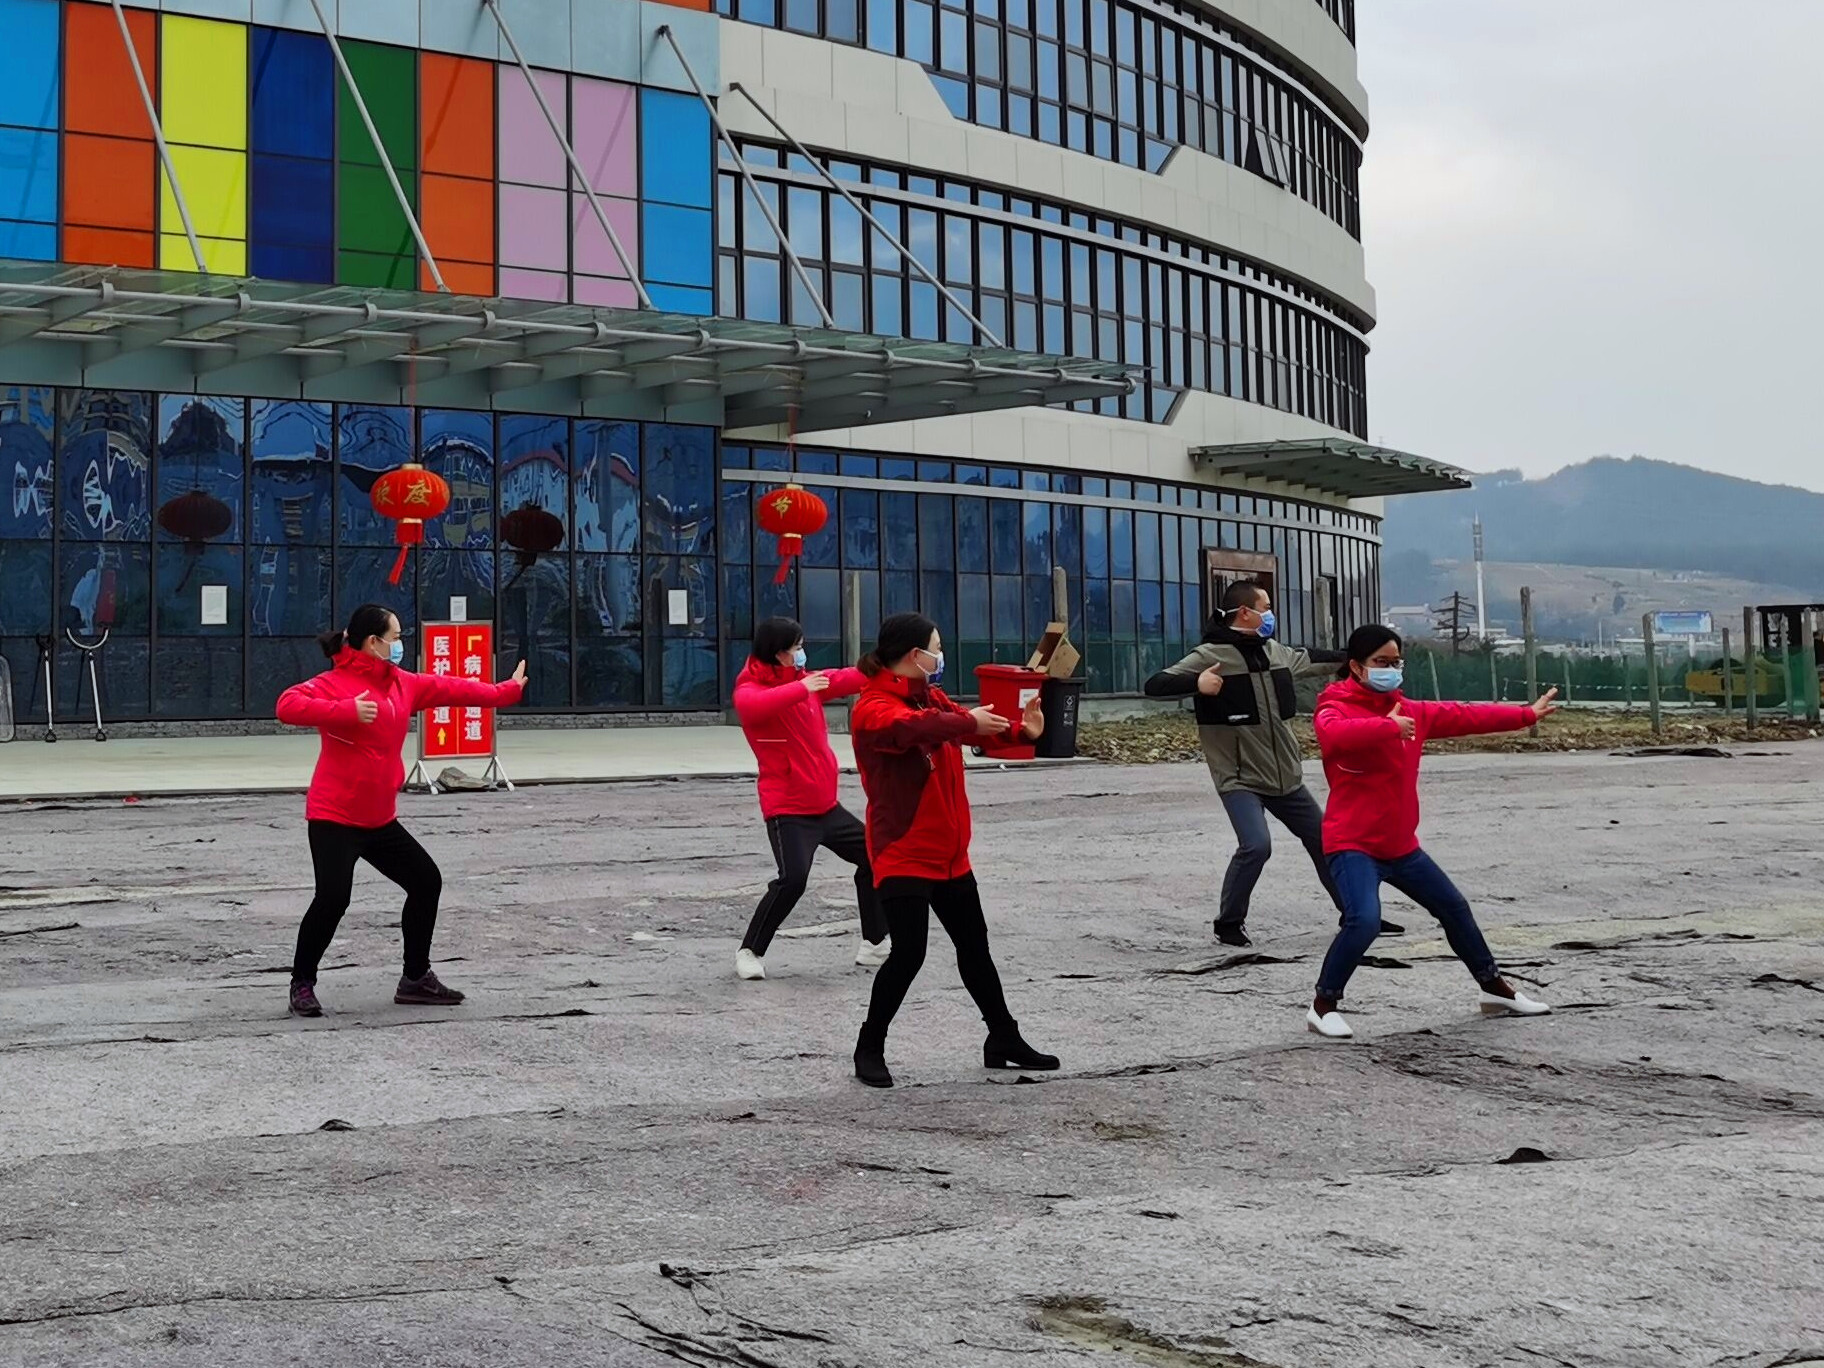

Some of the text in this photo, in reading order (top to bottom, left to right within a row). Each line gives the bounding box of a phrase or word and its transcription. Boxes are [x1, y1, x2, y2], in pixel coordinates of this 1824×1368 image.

[433, 636, 451, 723] 医护道
[464, 655, 482, 740] 病通道
